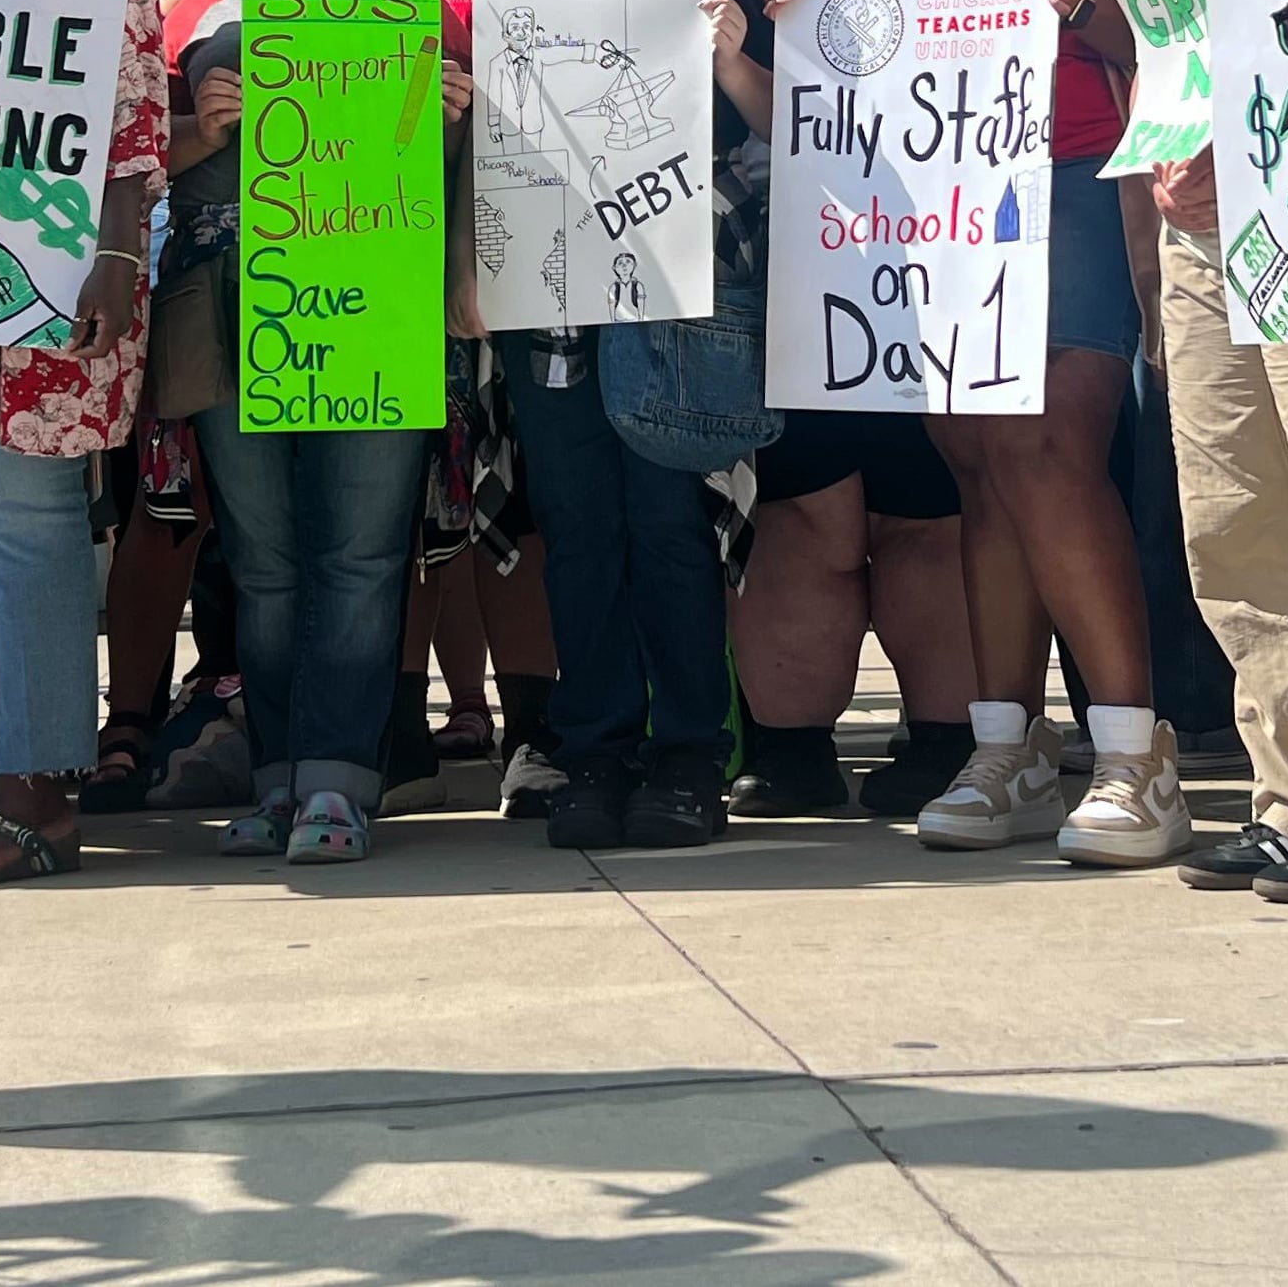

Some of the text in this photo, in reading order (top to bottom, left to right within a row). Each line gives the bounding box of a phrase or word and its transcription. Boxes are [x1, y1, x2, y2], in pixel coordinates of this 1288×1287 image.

[891, 7, 900, 45] UNION
[915, 38, 995, 60] UNION
[917, 9, 1031, 35] TEACHERS
[249, 32, 416, 99] Support
[832, 56, 849, 70] AFT
[851, 62, 880, 73] LOCAL
[254, 96, 355, 169] Our
[791, 84, 884, 178] Fully
[477, 158, 515, 174] Chicago
[508, 166, 537, 178] Public
[527, 172, 566, 186] Schools
[248, 170, 436, 241] Students
[575, 151, 704, 242] THE DEBT.
[820, 184, 984, 250] Schools
[246, 246, 368, 320] Save
[873, 263, 930, 309] on
[247, 318, 336, 375] Our
[823, 259, 1020, 414] Day 1
[246, 370, 404, 427] Schools
